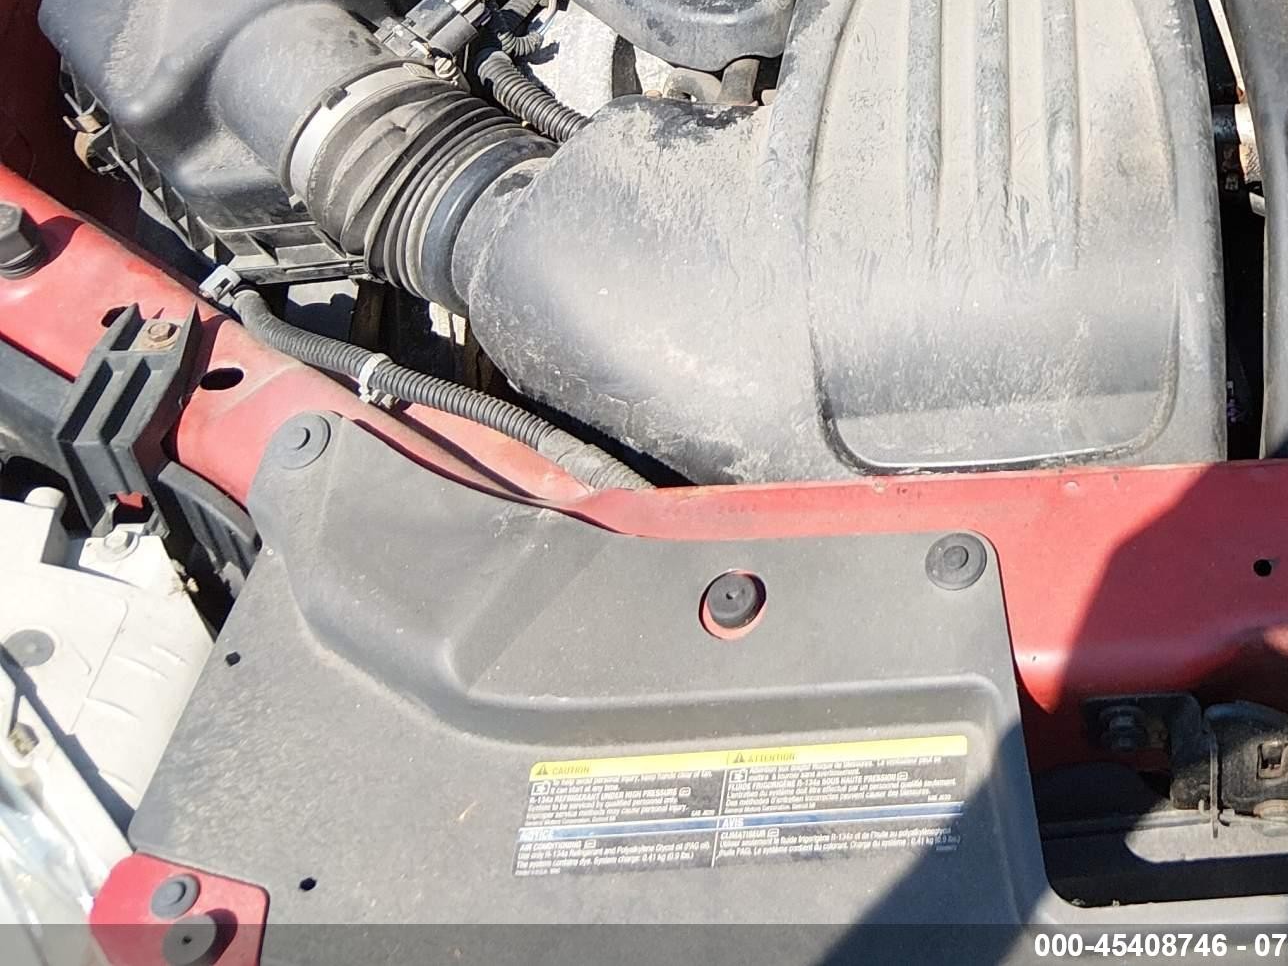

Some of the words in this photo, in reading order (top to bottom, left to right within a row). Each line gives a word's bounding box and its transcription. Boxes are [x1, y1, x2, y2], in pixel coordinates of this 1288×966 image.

[551, 766, 590, 774] CAUTION
[554, 793, 601, 803] REFRIGERANT
[601, 791, 624, 800] UNDER
[642, 788, 679, 798] PRESSURE
[722, 817, 745, 829] AVIS
